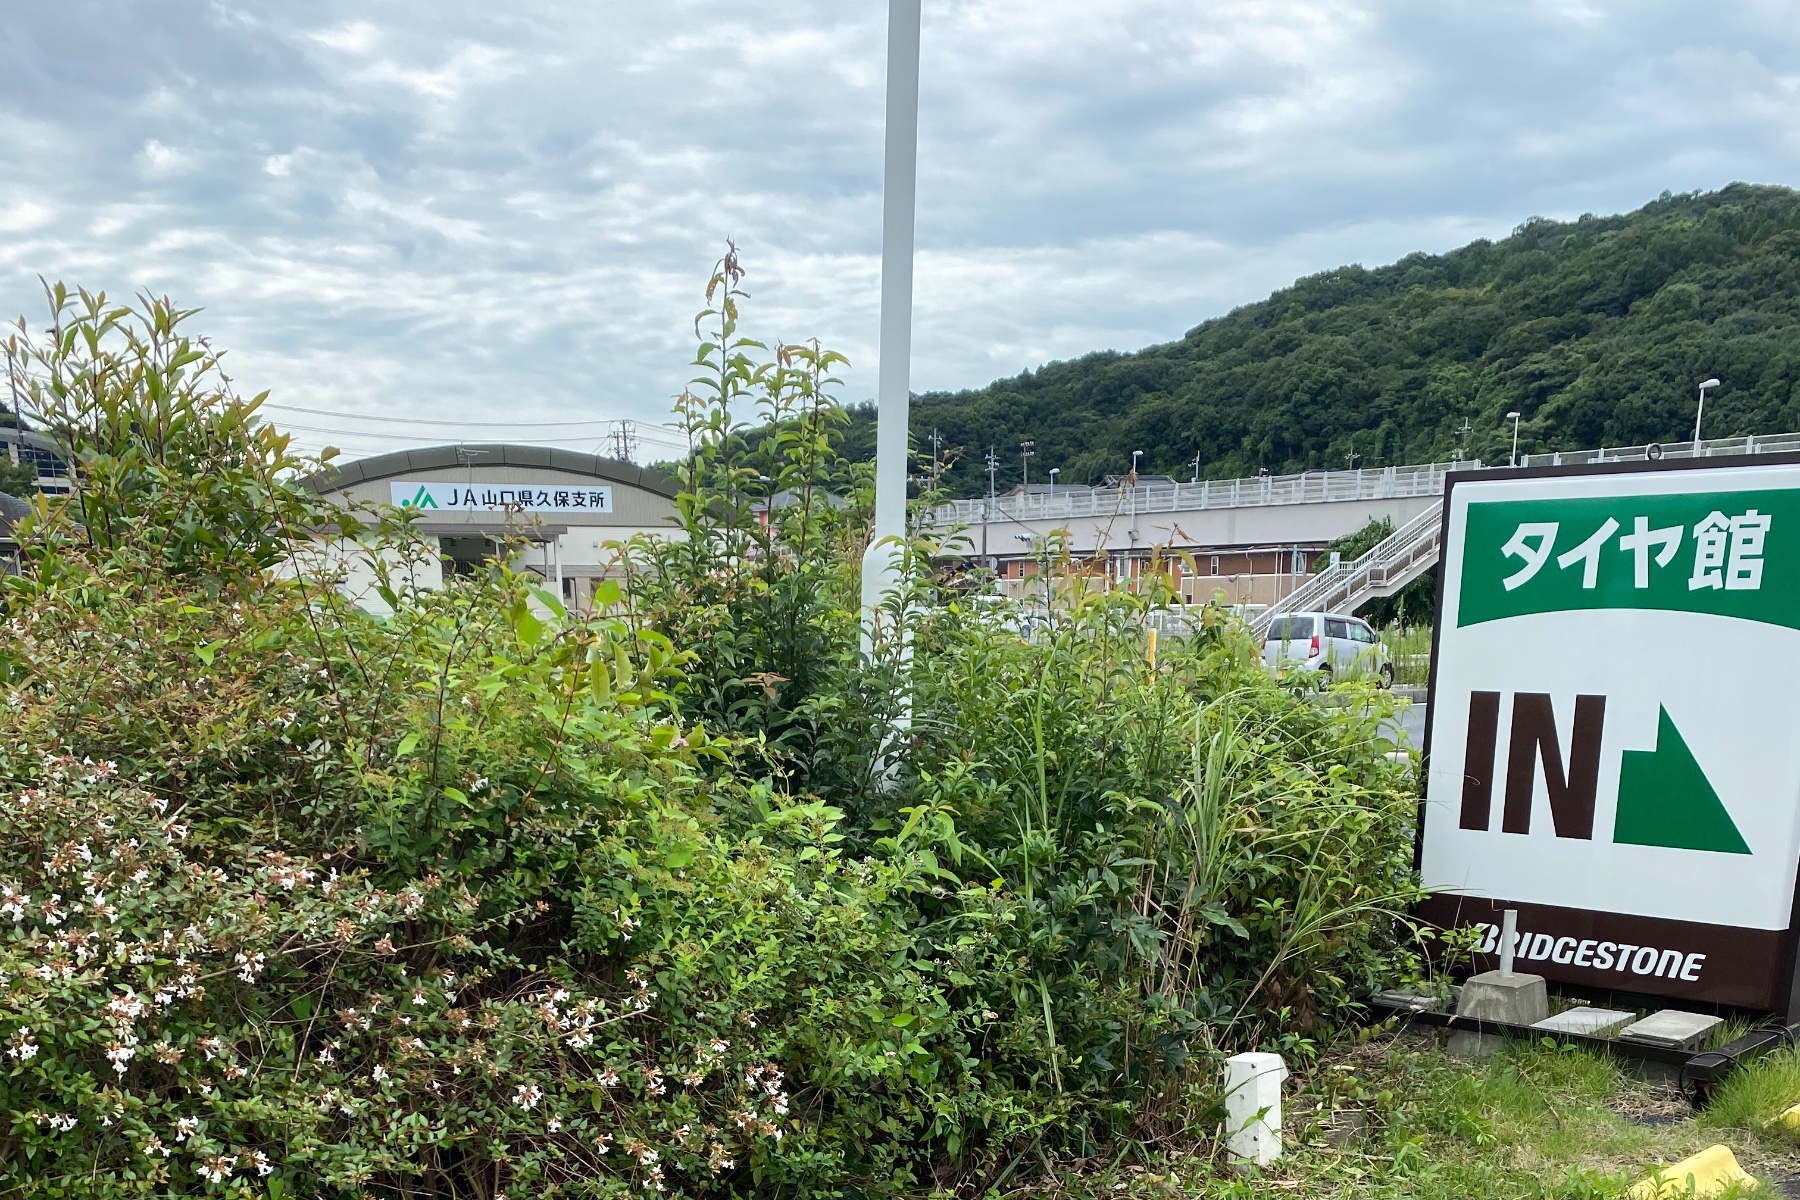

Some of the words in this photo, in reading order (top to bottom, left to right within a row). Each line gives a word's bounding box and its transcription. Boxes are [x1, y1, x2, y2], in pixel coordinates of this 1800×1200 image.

[1500, 508, 1772, 592] タイヤ館
[1458, 690, 1607, 841] IN
